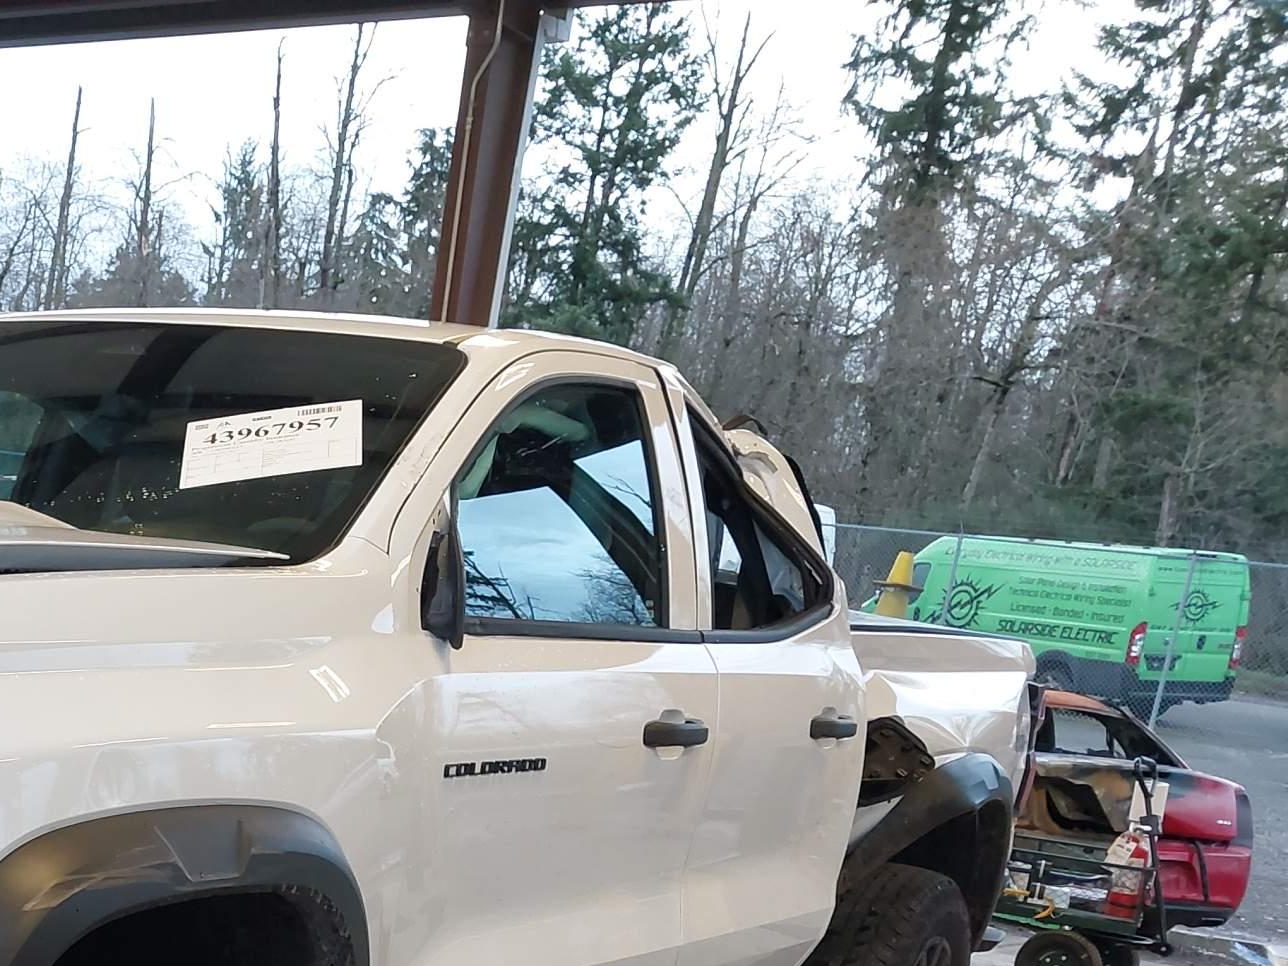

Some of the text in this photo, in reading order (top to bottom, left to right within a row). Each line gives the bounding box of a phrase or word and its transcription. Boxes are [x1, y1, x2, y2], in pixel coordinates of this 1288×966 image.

[202, 416, 340, 445] 43967957
[1010, 602, 1047, 615] Licensed
[1052, 606, 1084, 619] Bonded
[996, 619, 1120, 645] SOLARSIDE ELECTRIC
[443, 758, 547, 778] COLORADO
